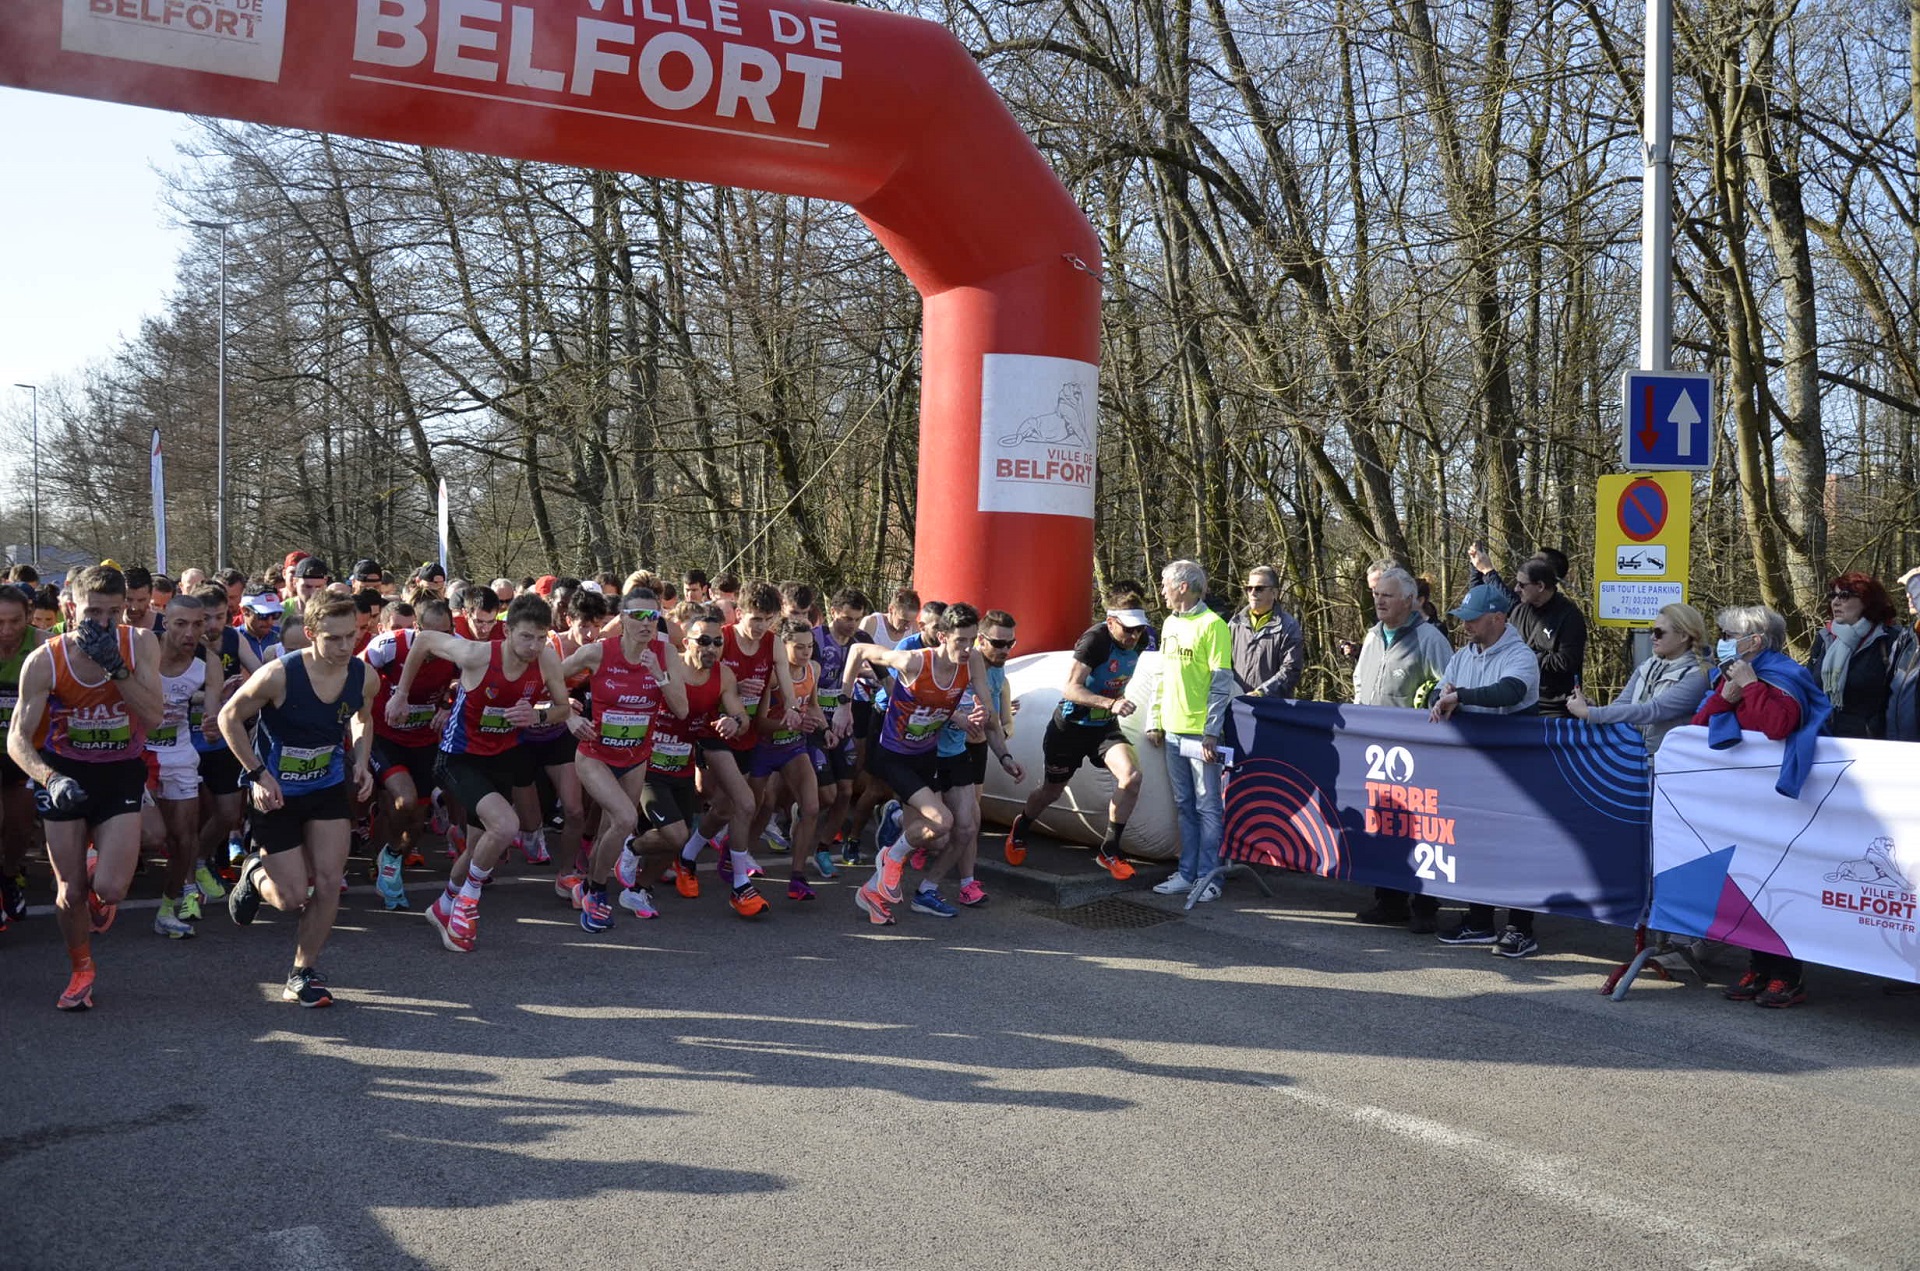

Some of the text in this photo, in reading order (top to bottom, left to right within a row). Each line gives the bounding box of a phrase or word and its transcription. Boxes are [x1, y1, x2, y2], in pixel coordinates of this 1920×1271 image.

[769, 9, 842, 53] DE
[353, 0, 841, 129] BELFORT
[1048, 448, 1093, 465] VILLE DE
[996, 458, 1091, 484] BELFORT
[1601, 584, 1679, 594] SUR TOUT LE PARKING
[1611, 606, 1619, 614] De
[1624, 606, 1639, 615] 7h00
[1648, 607, 1659, 615] 12h
[617, 694, 647, 703] MBA
[88, 729, 110, 739] 19
[620, 725, 629, 737] 2
[72, 740, 115, 749] CRAFT
[601, 737, 636, 747] CRAFT
[298, 758, 316, 772] 30
[1365, 744, 1414, 782] 20
[280, 770, 320, 780] CRAFT
[1364, 781, 1437, 814] TERRE
[1365, 808, 1455, 845] DE JEUX
[1414, 842, 1456, 883] 24
[1861, 886, 1917, 903] VILLE DE
[1821, 890, 1916, 918] BELFORT
[1858, 916, 1915, 932] BELFORT.FR
